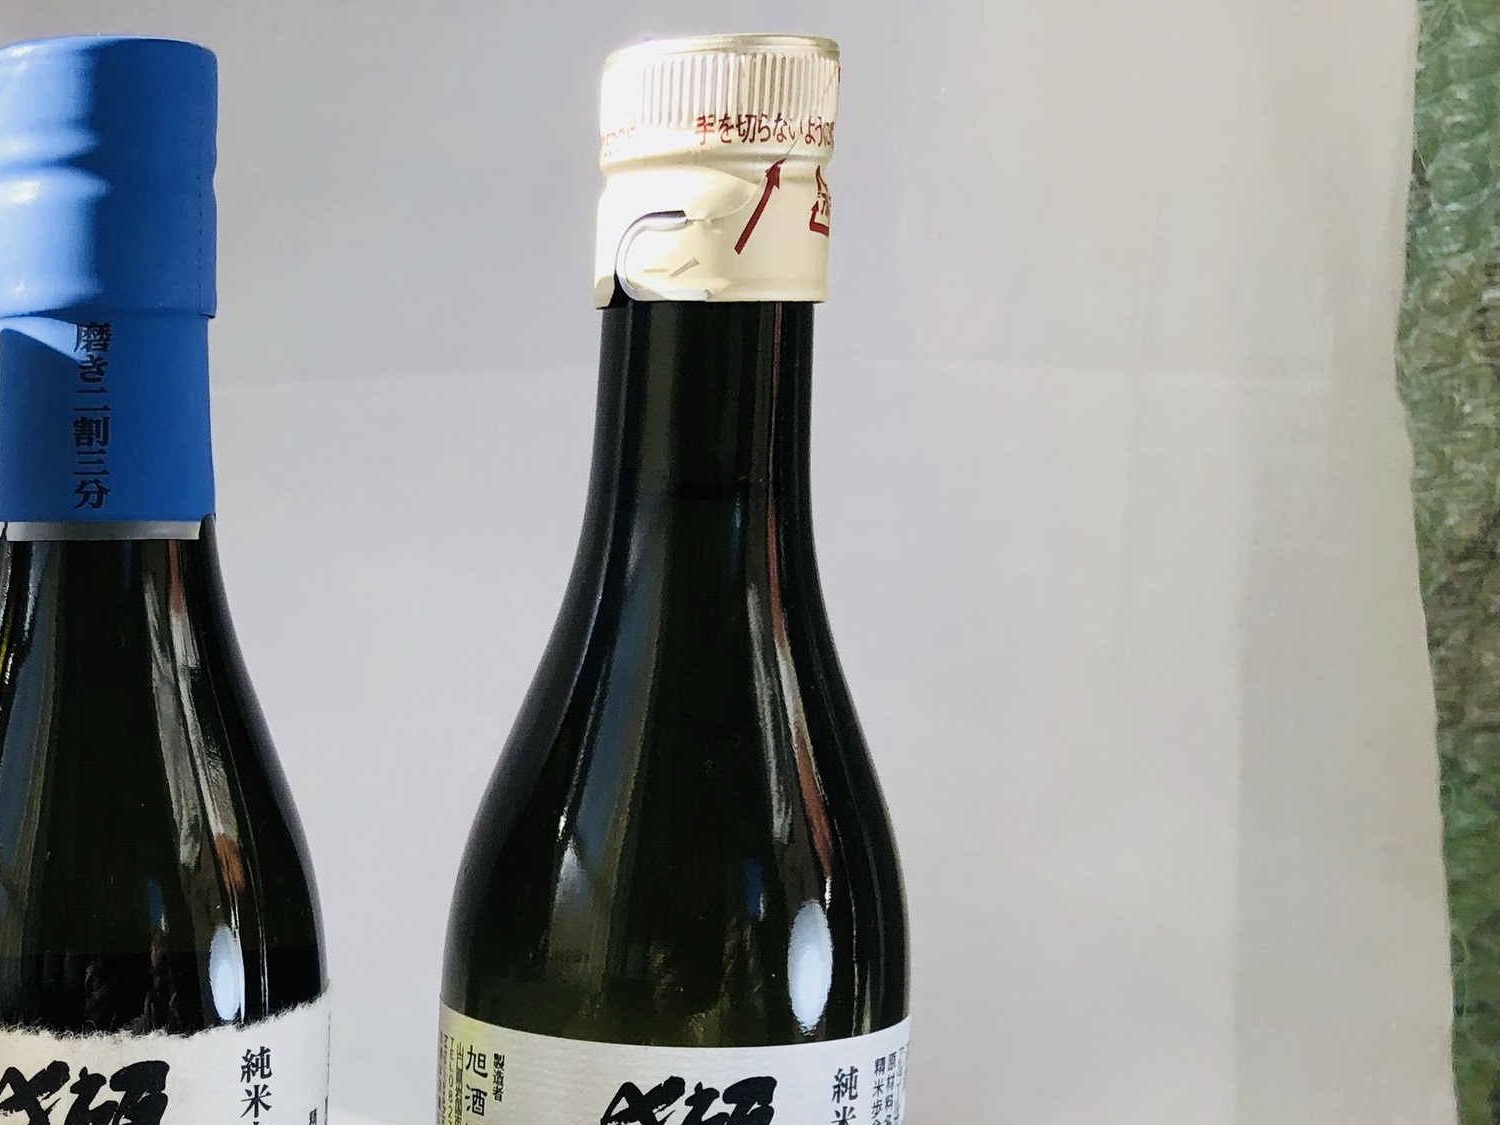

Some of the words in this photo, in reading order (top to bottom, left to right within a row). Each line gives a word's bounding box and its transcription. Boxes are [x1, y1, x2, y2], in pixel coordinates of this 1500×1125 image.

[73, 322, 112, 509] 磨き二割三分
[492, 1053, 505, 1102] 製造者
